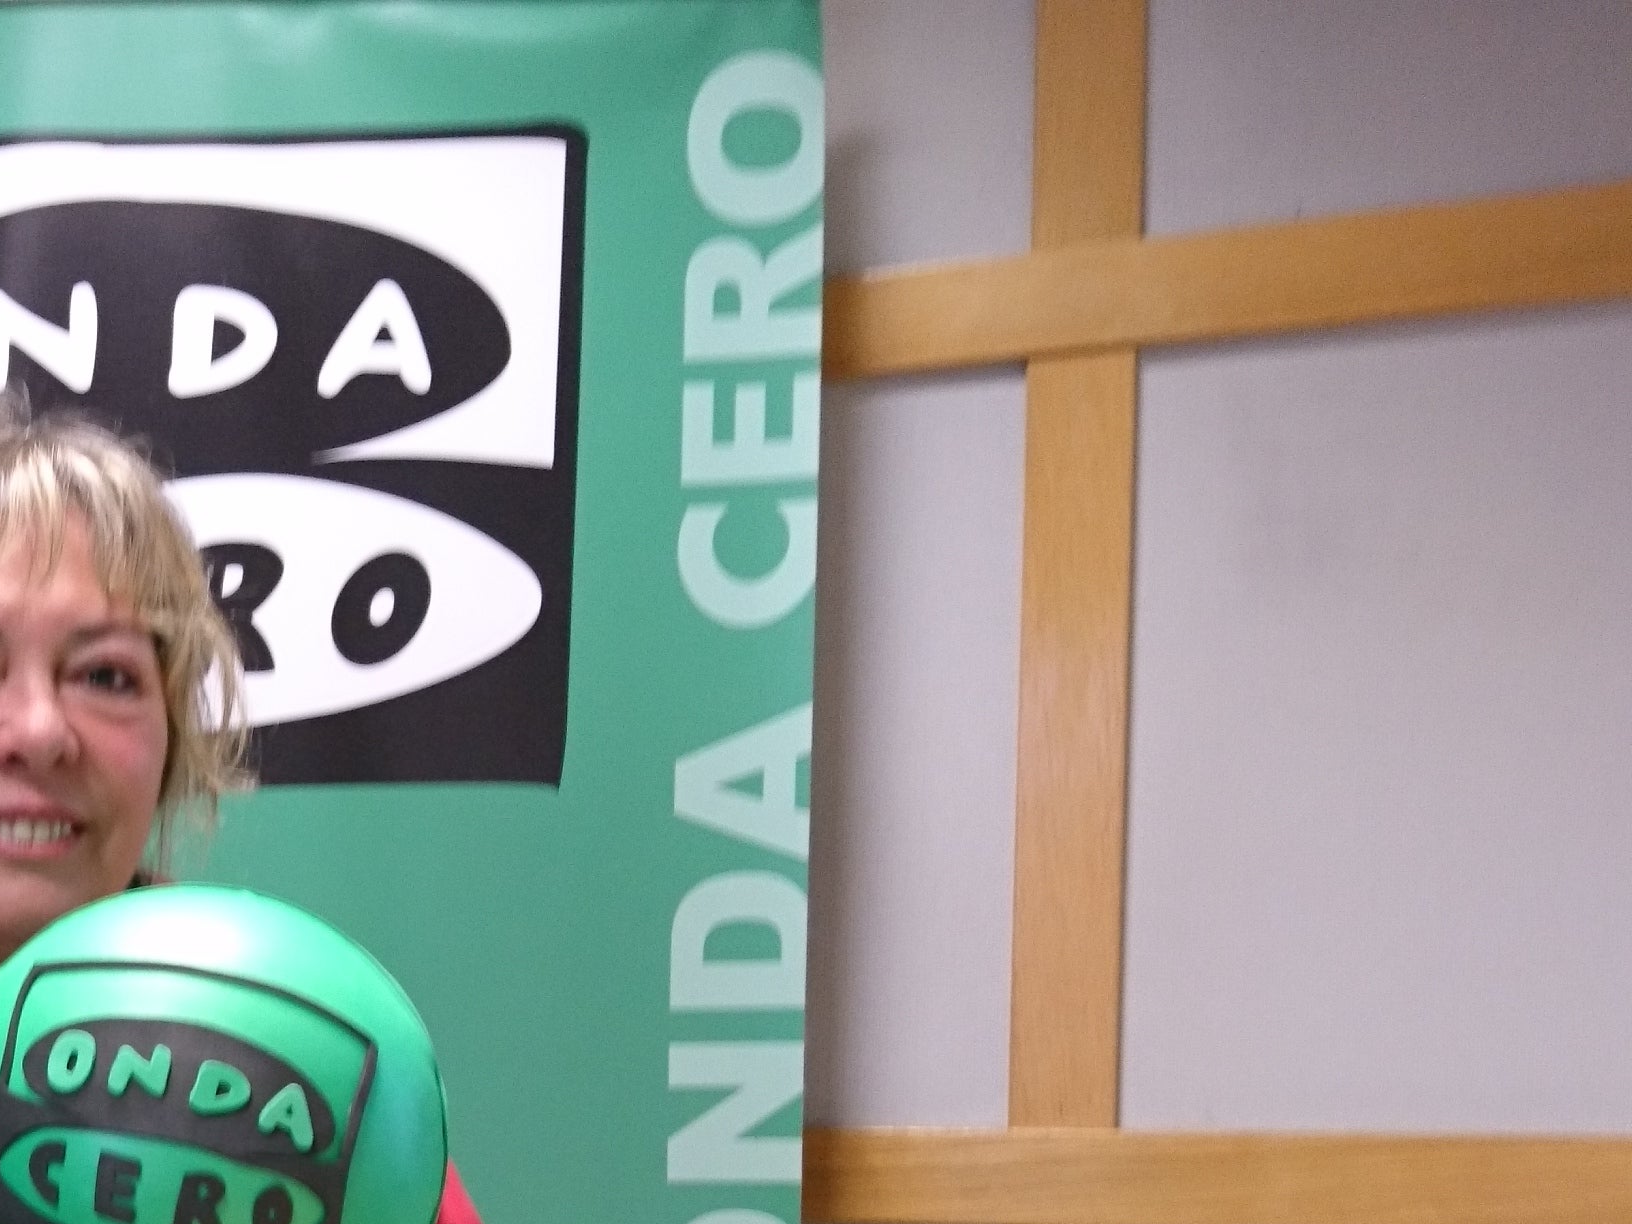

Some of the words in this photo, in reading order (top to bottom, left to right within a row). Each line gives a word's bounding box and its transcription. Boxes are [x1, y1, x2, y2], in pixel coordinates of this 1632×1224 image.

[677, 50, 825, 630] CERO
[199, 542, 431, 672] RO
[46, 1028, 313, 1152] ONDA
